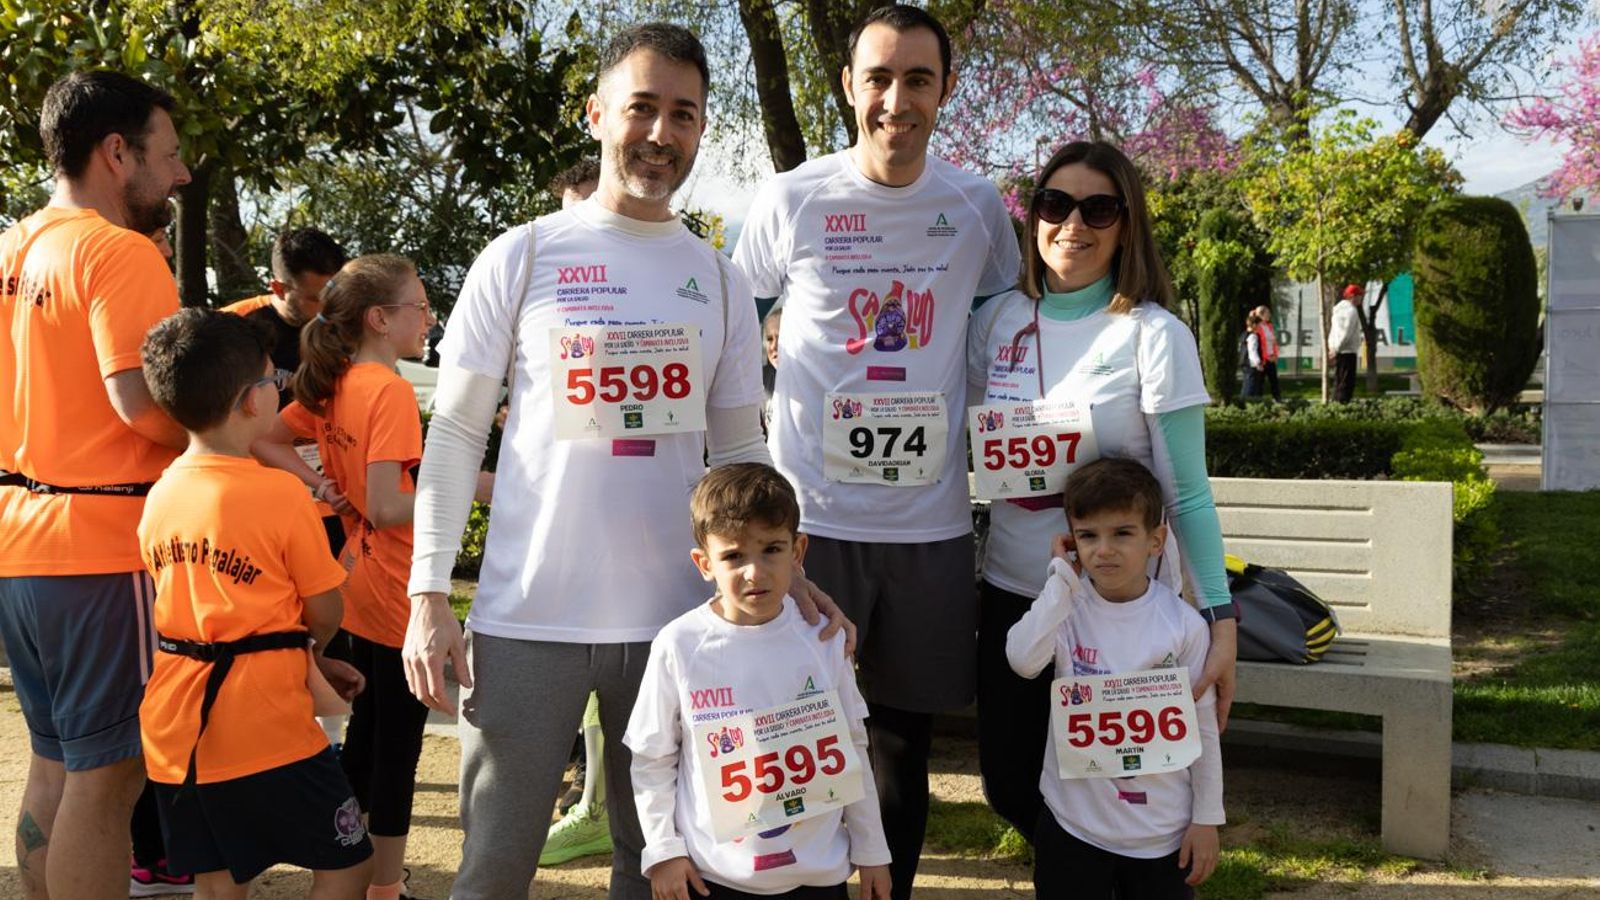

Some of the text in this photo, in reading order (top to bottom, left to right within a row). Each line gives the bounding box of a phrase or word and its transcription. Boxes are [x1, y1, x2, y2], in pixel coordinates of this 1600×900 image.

[825, 214, 867, 232] XXVII
[852, 235, 884, 243] POPULAR
[557, 265, 607, 284] XXVII
[557, 287, 628, 296] CARRERA POPULAR
[607, 328, 685, 341] XXVII CARRERA POPULAR
[566, 363, 691, 405] 5598
[620, 404, 644, 412] PEDRO
[891, 397, 913, 405] CARRERA
[849, 426, 927, 458] 974
[984, 432, 1082, 471] 5597
[201, 537, 264, 585] Pgalajar
[1103, 673, 1178, 689] XXVII CARRERA POPULAR
[690, 687, 735, 709] XXVII
[692, 712, 721, 722] CARRERA
[754, 699, 830, 728] XXVII CARRERA POPULAR
[1068, 706, 1187, 749] 5596
[1115, 745, 1144, 755] MARTÍN
[721, 735, 846, 802] 5595
